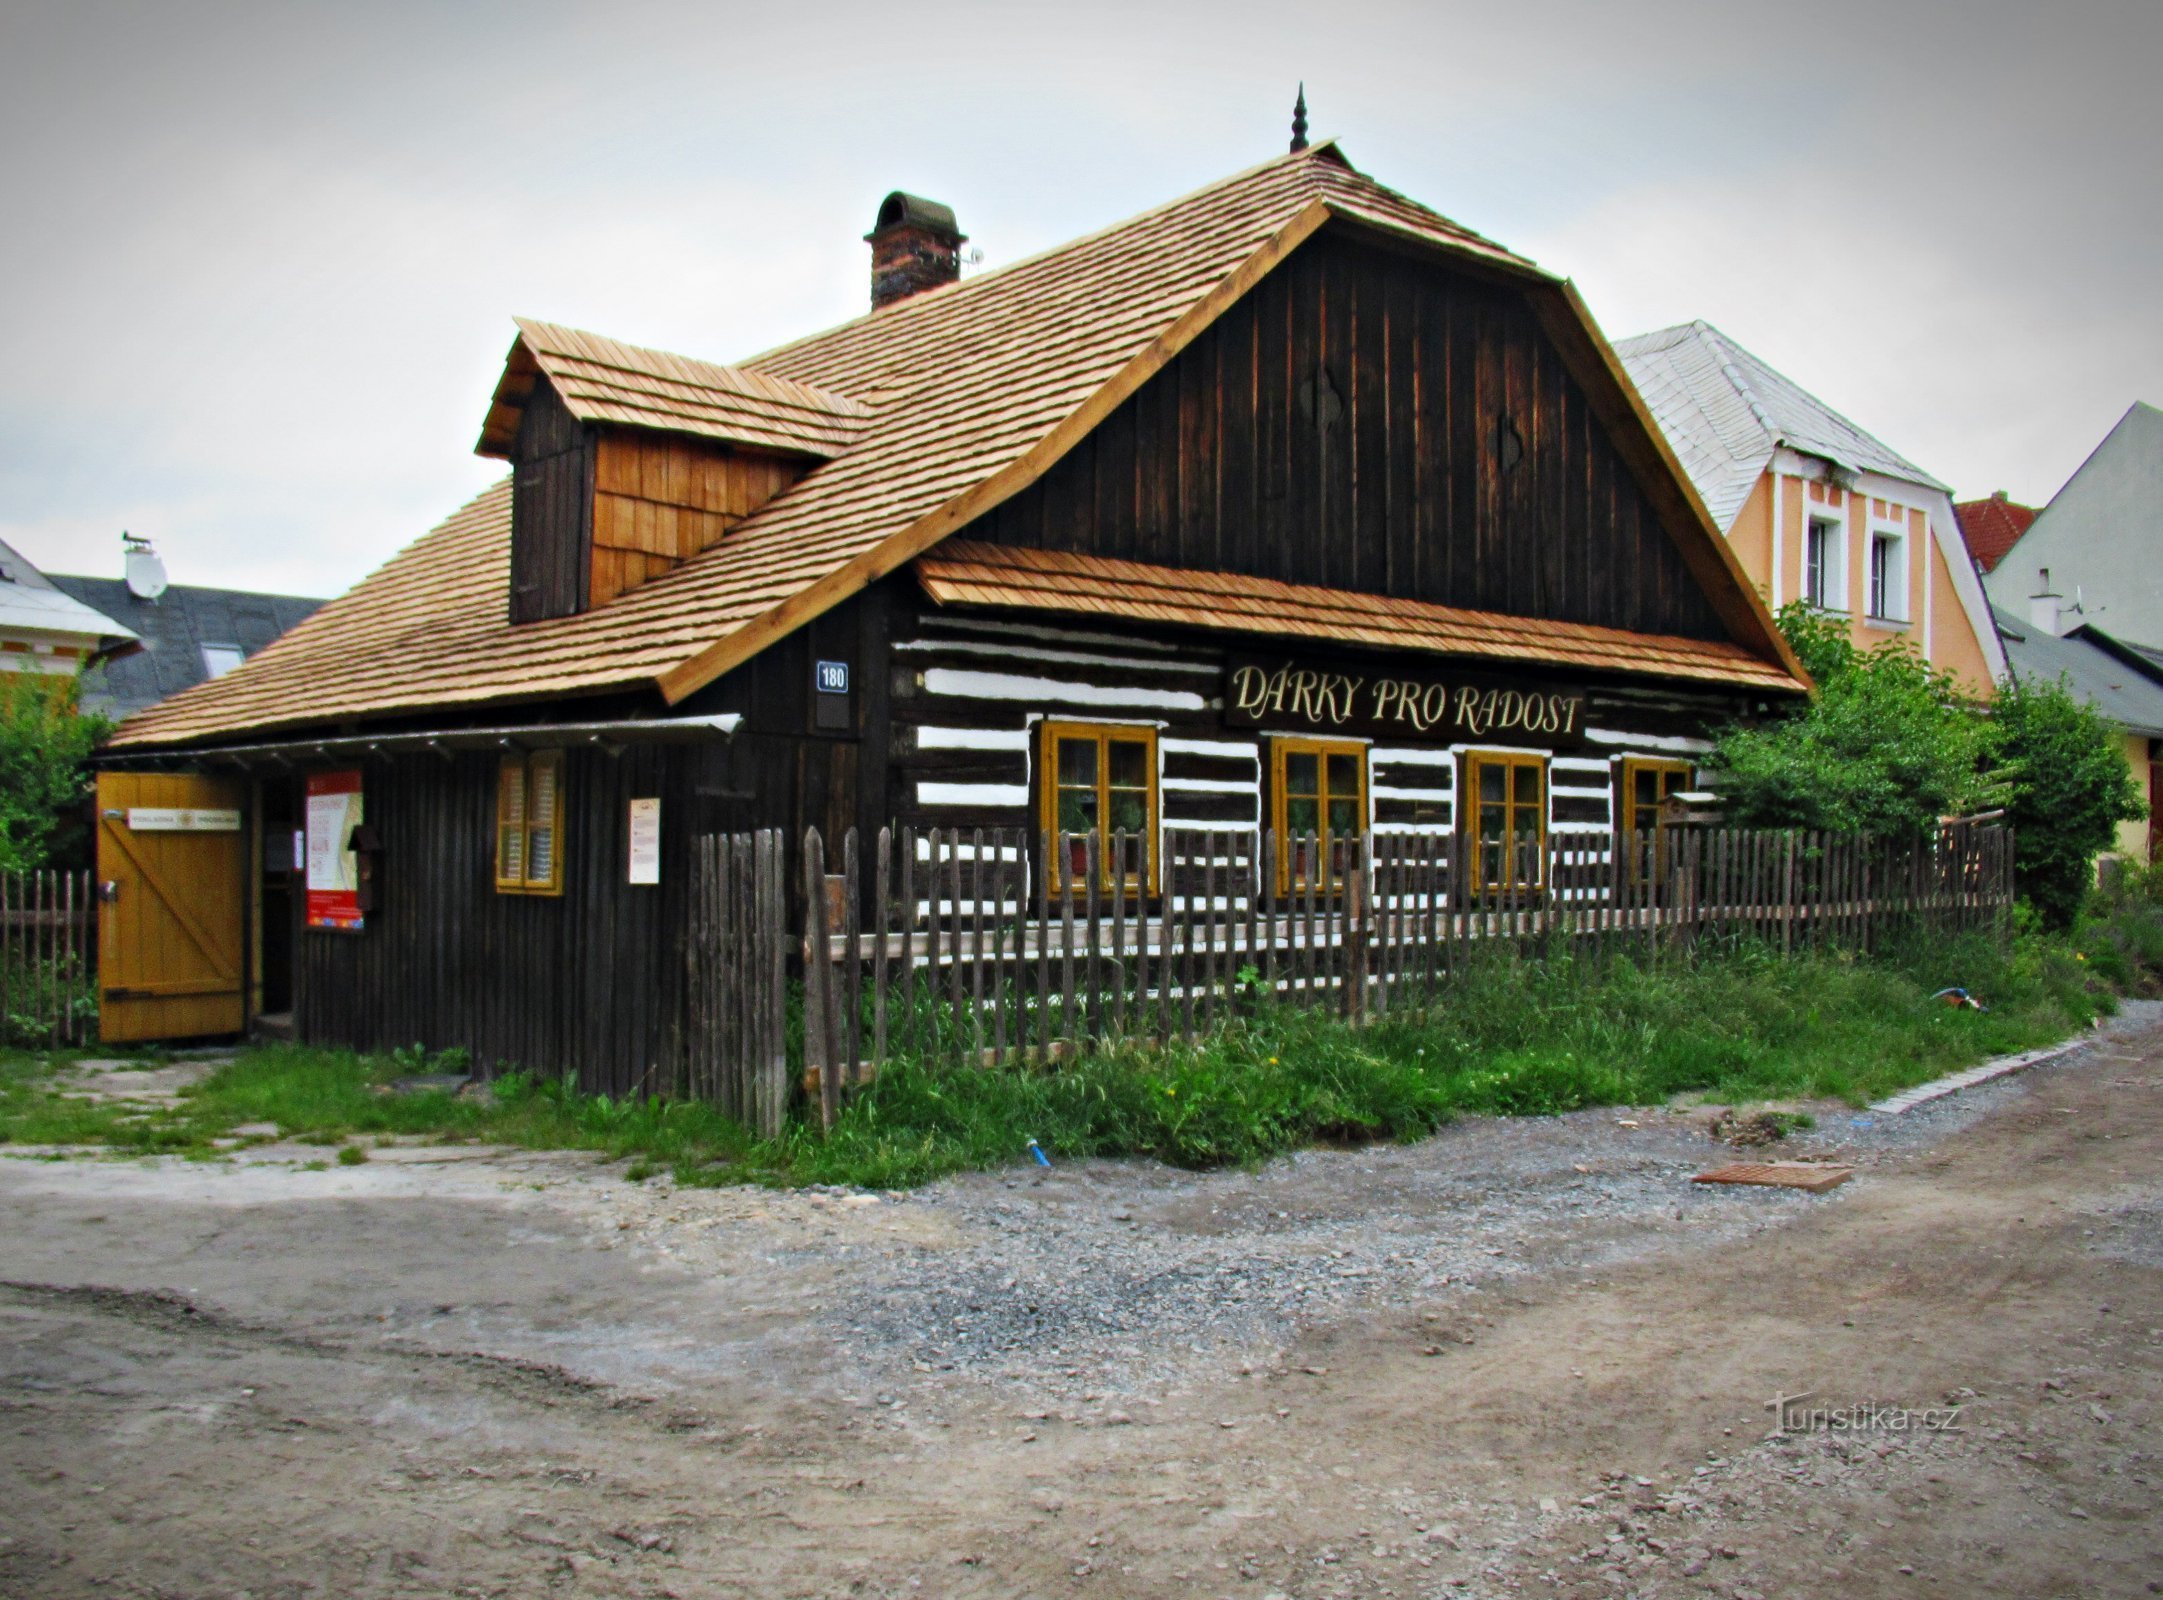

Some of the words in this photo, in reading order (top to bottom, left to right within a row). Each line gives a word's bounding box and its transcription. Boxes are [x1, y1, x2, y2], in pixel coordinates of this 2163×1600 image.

[822, 667, 845, 688] 180
[1233, 660, 1364, 724] DÁRKY
[1372, 679, 1446, 731] PRO
[1454, 686, 1584, 736] RADOST
